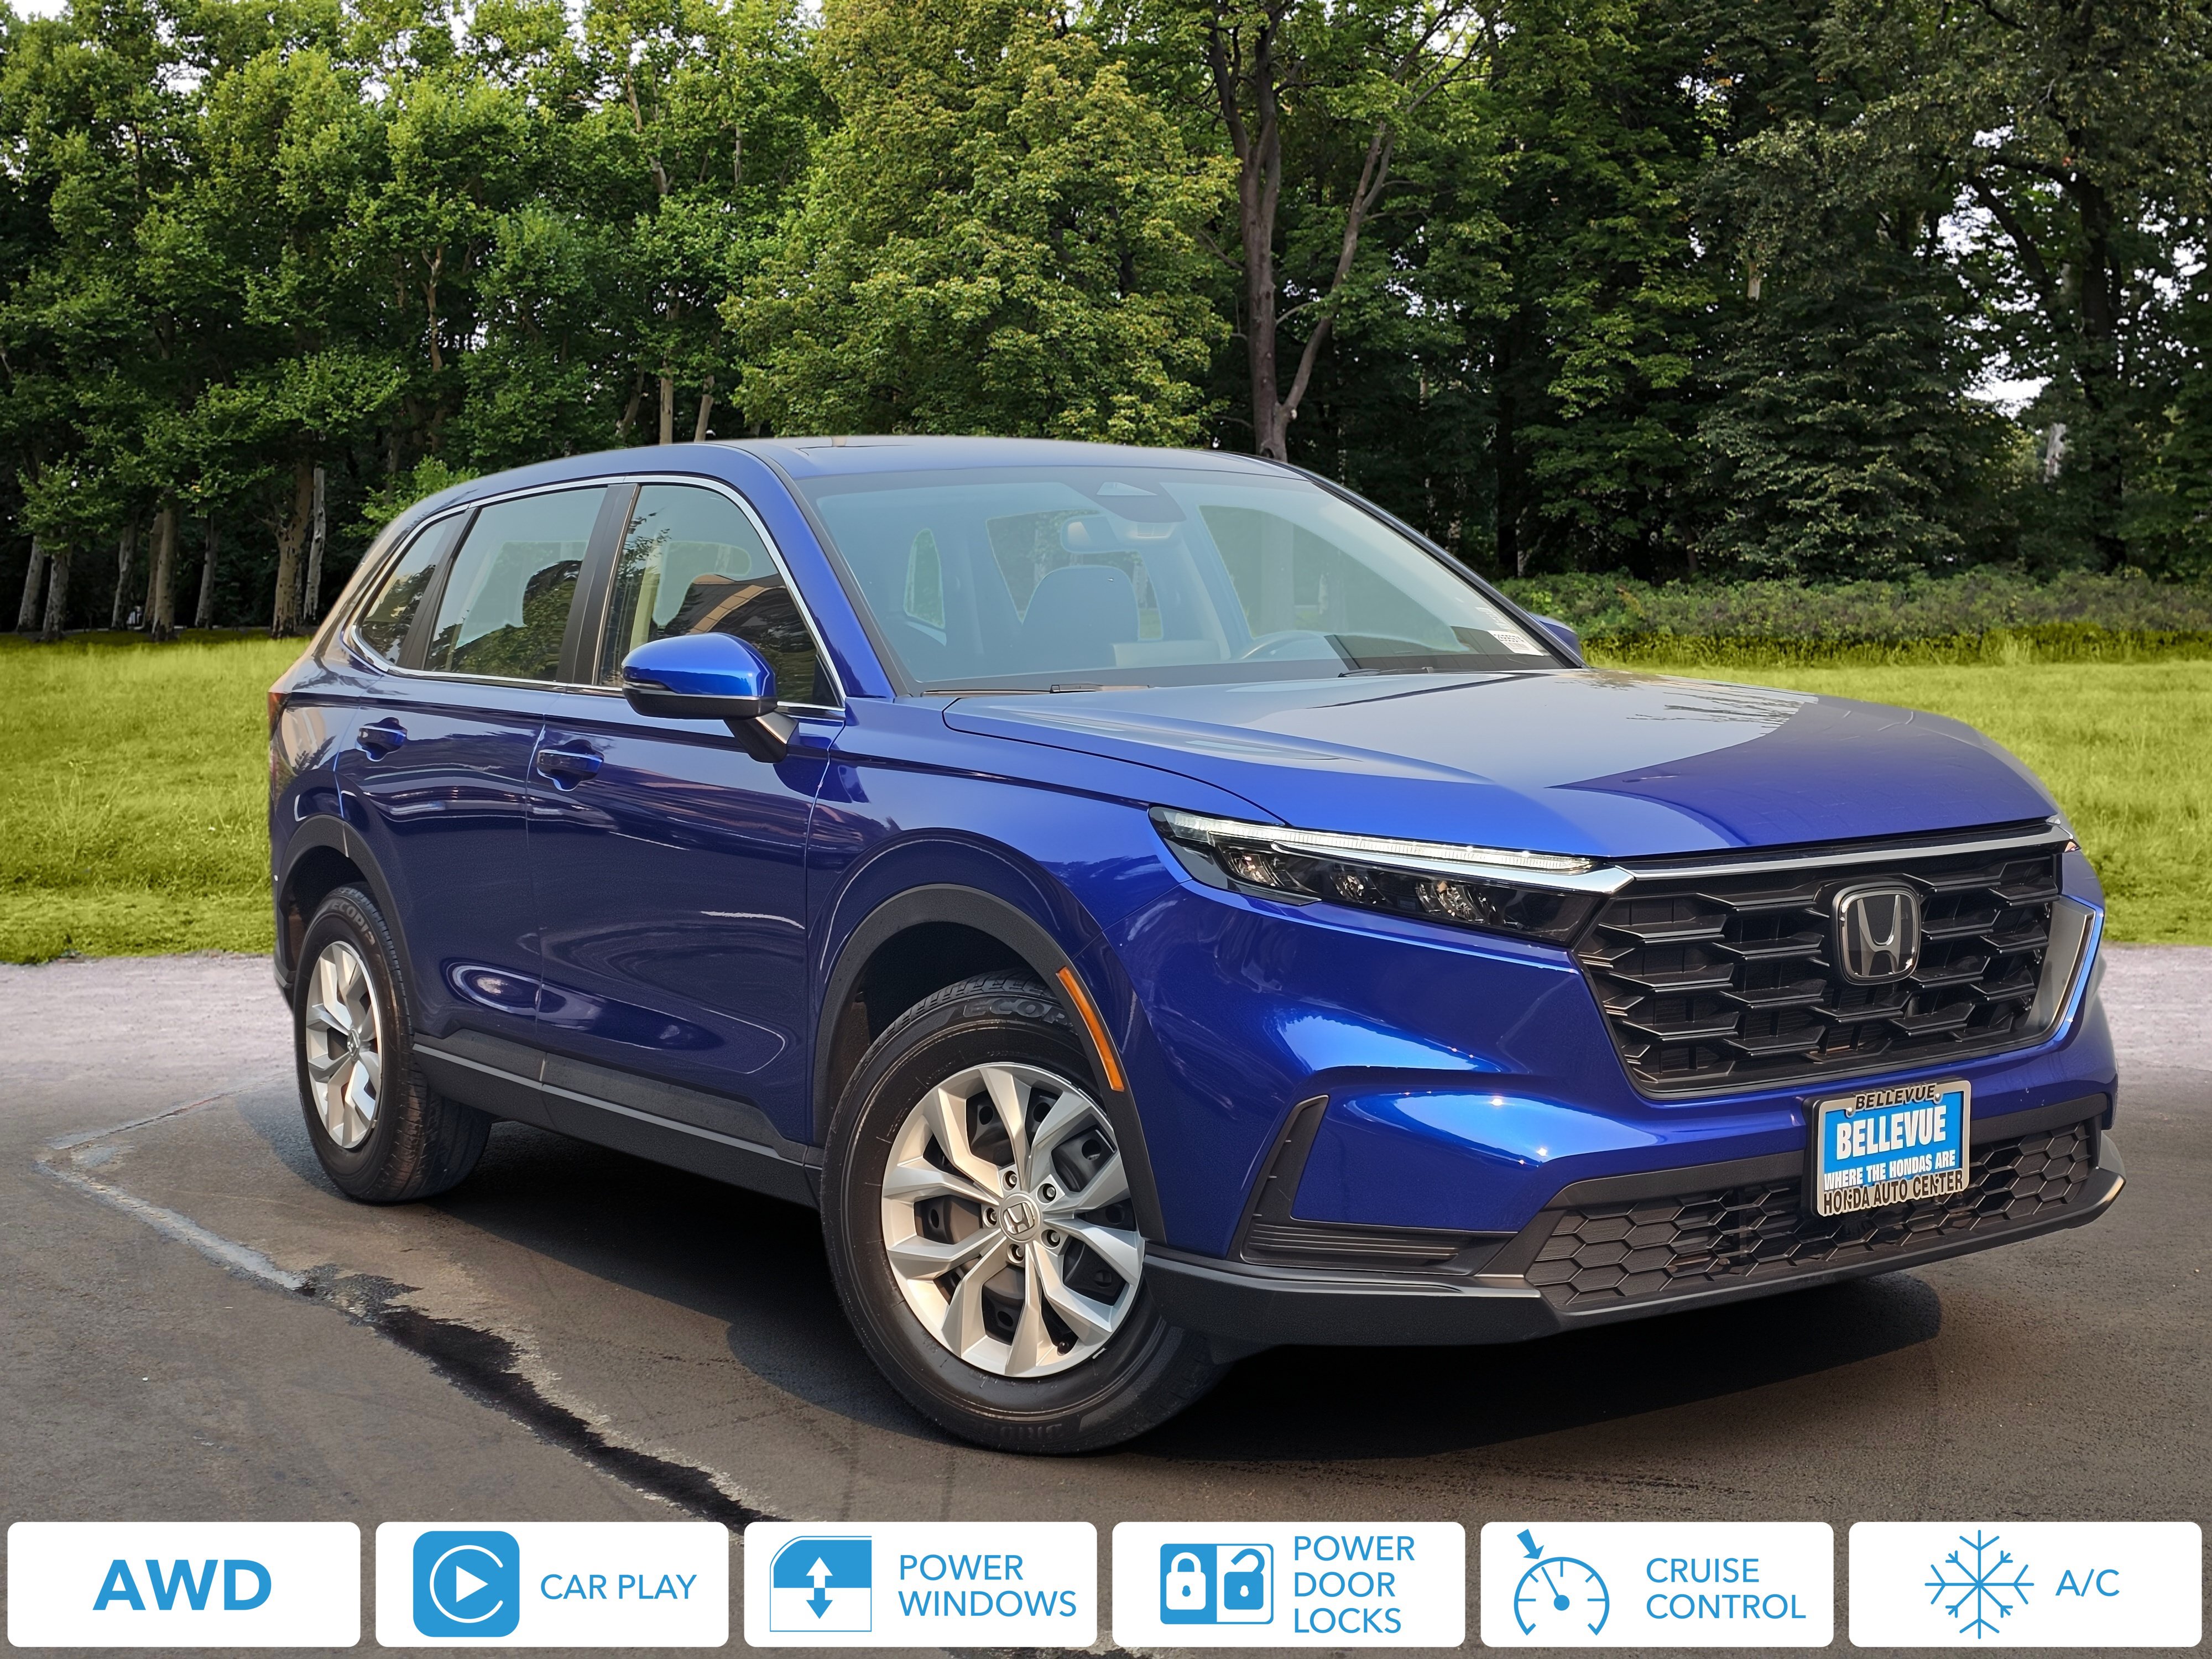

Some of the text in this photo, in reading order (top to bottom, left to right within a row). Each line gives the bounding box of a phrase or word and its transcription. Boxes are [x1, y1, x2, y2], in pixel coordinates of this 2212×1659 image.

[963, 998, 1072, 1026] ECOP
[1855, 1084, 1936, 1110] BELLEVUE
[1836, 1105, 1947, 1160] BELLEVUE
[1824, 1149, 1956, 1191] WHERE THE HONDAS ARE
[1824, 1170, 1963, 1214] HONDA AUTO CENTER
